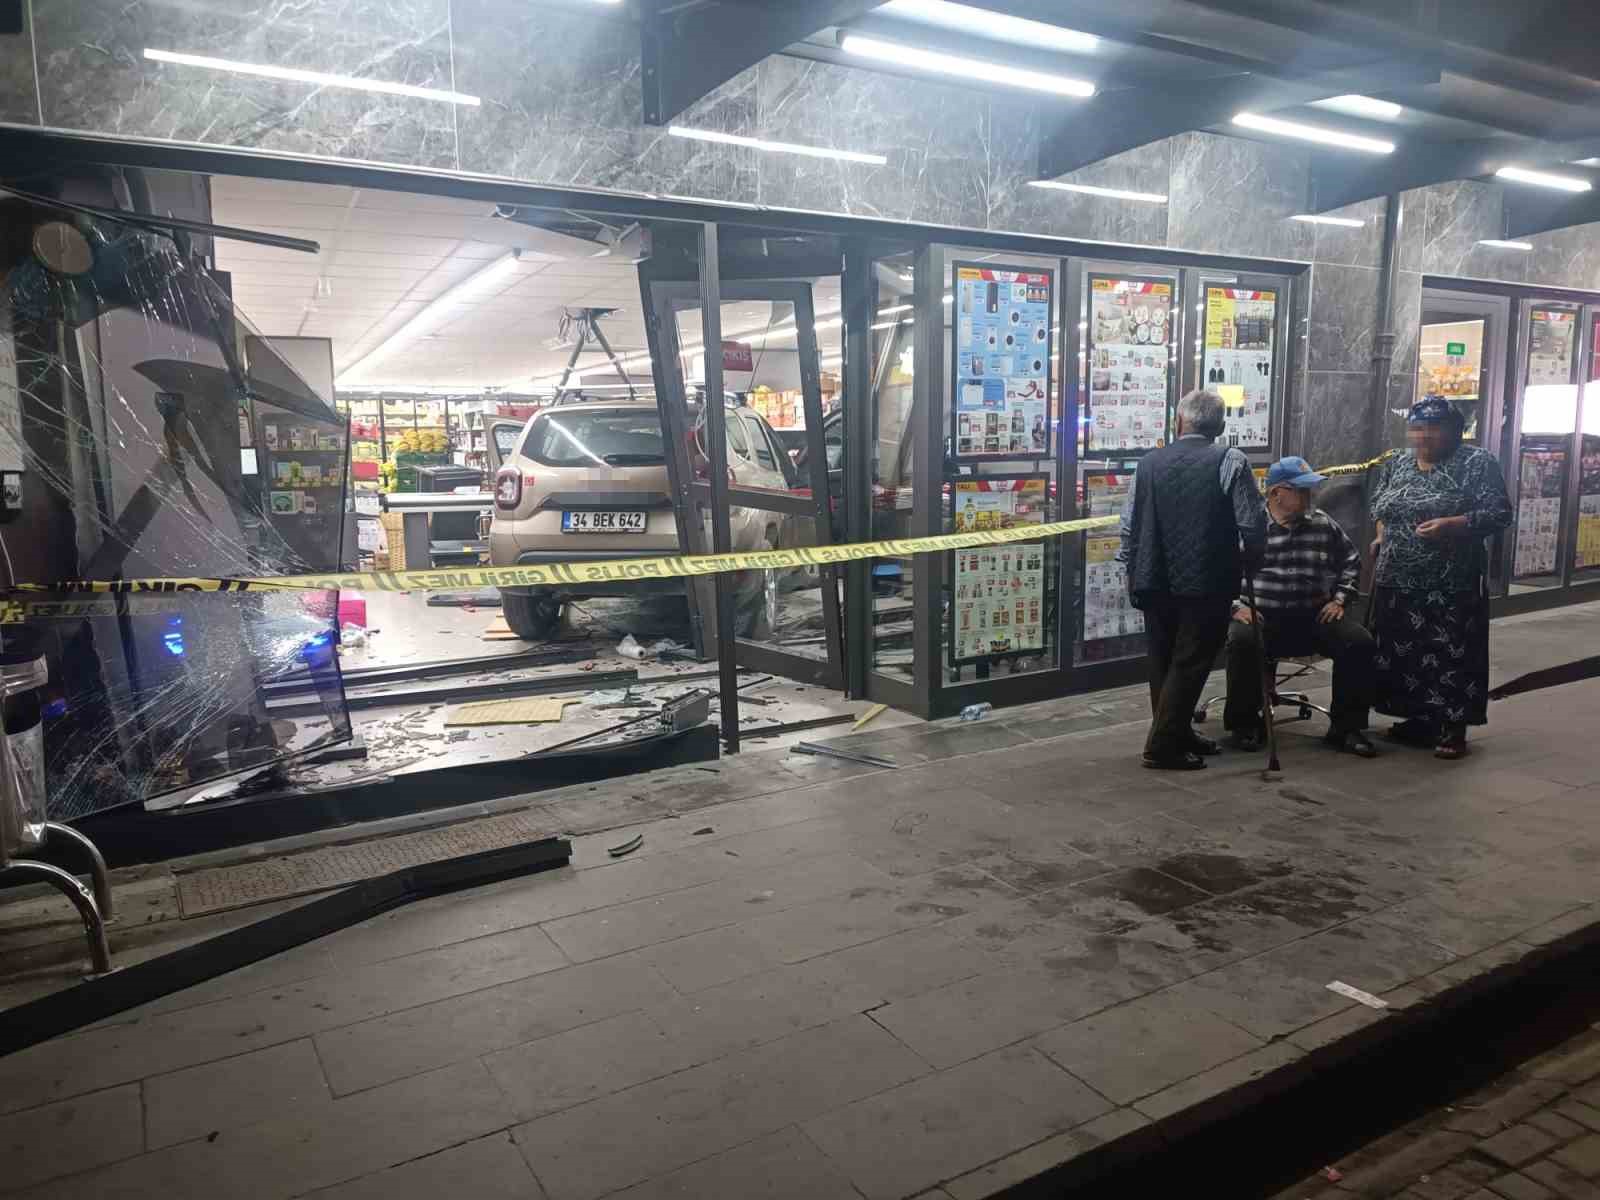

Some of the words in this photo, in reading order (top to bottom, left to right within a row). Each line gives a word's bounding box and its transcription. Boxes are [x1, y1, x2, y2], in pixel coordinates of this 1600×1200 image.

[573, 513, 587, 527] 34
[593, 513, 615, 527] BEK
[619, 513, 641, 527] 642
